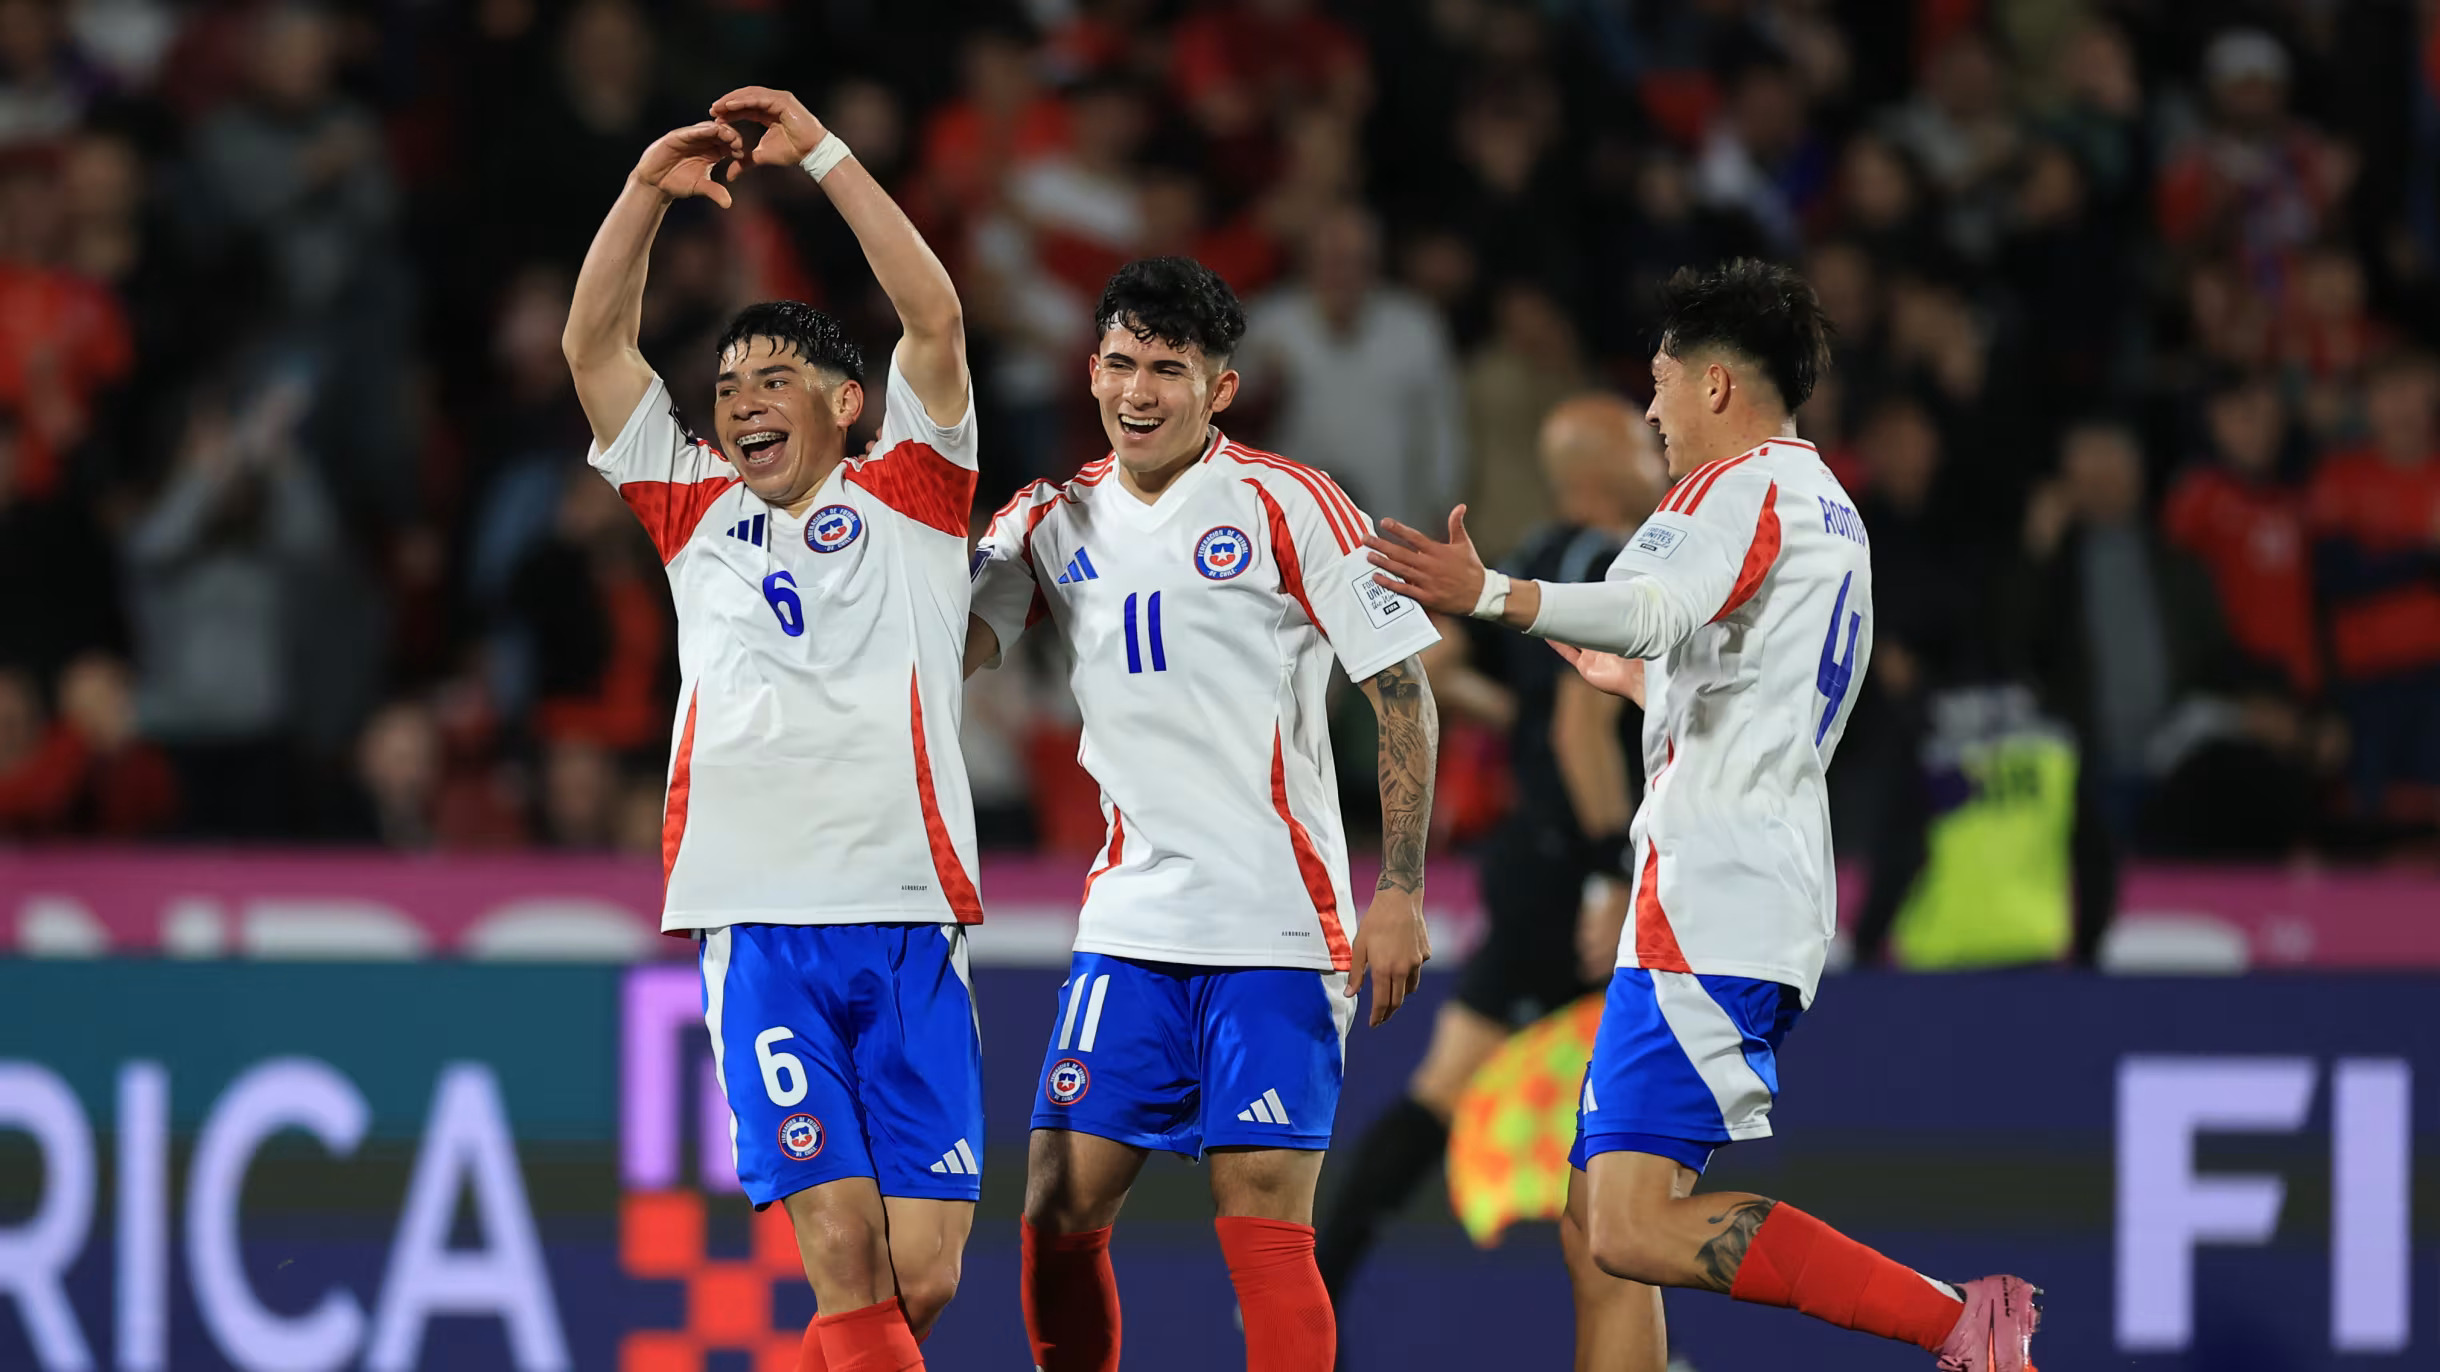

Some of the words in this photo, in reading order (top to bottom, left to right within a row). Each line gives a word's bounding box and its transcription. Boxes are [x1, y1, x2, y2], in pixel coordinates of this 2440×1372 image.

[762, 570, 804, 637] 6
[1124, 590, 1167, 674] 11
[1815, 570, 1861, 749] 4
[1058, 972, 1110, 1053] 11
[754, 1026, 809, 1107] 6
[2114, 1054, 2412, 1353] FI
